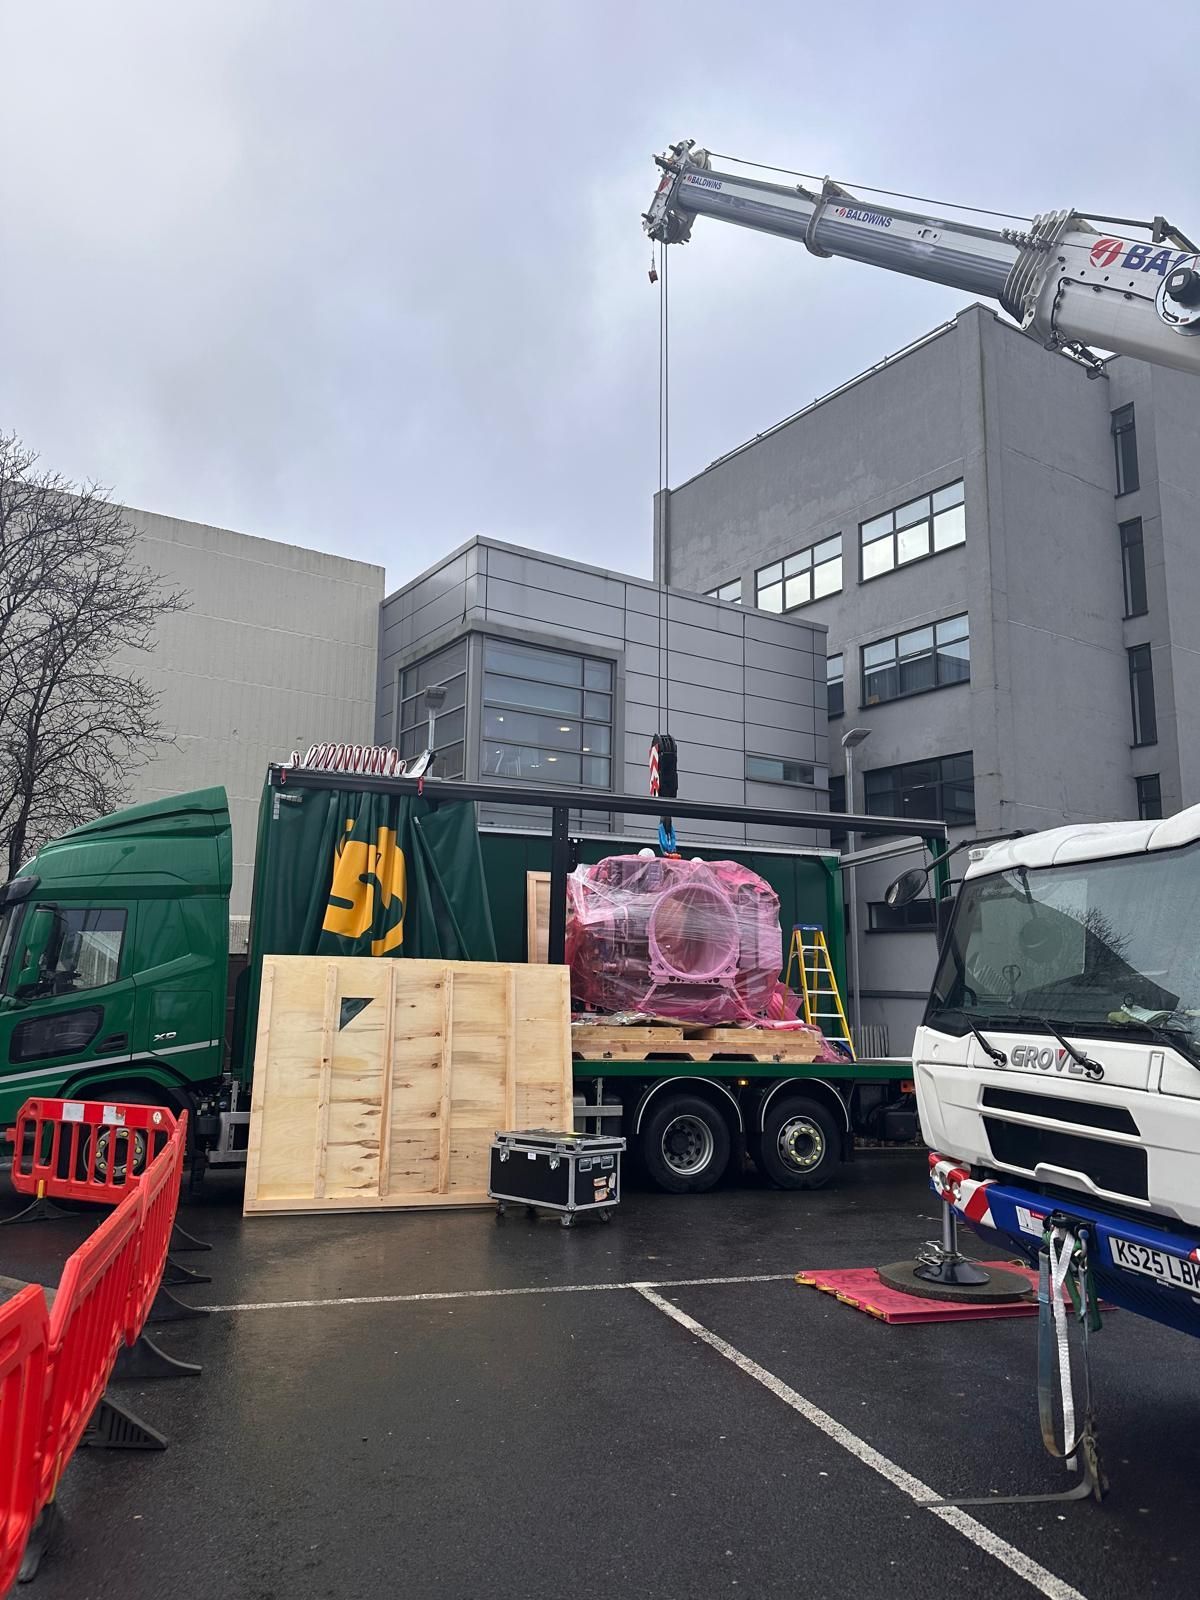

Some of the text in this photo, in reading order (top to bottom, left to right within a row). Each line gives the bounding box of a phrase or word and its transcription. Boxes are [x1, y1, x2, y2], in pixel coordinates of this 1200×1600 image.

[691, 176, 722, 190] BALDWINS
[846, 209, 893, 228] BALDWINS
[1115, 1239, 1164, 1275] KS25
